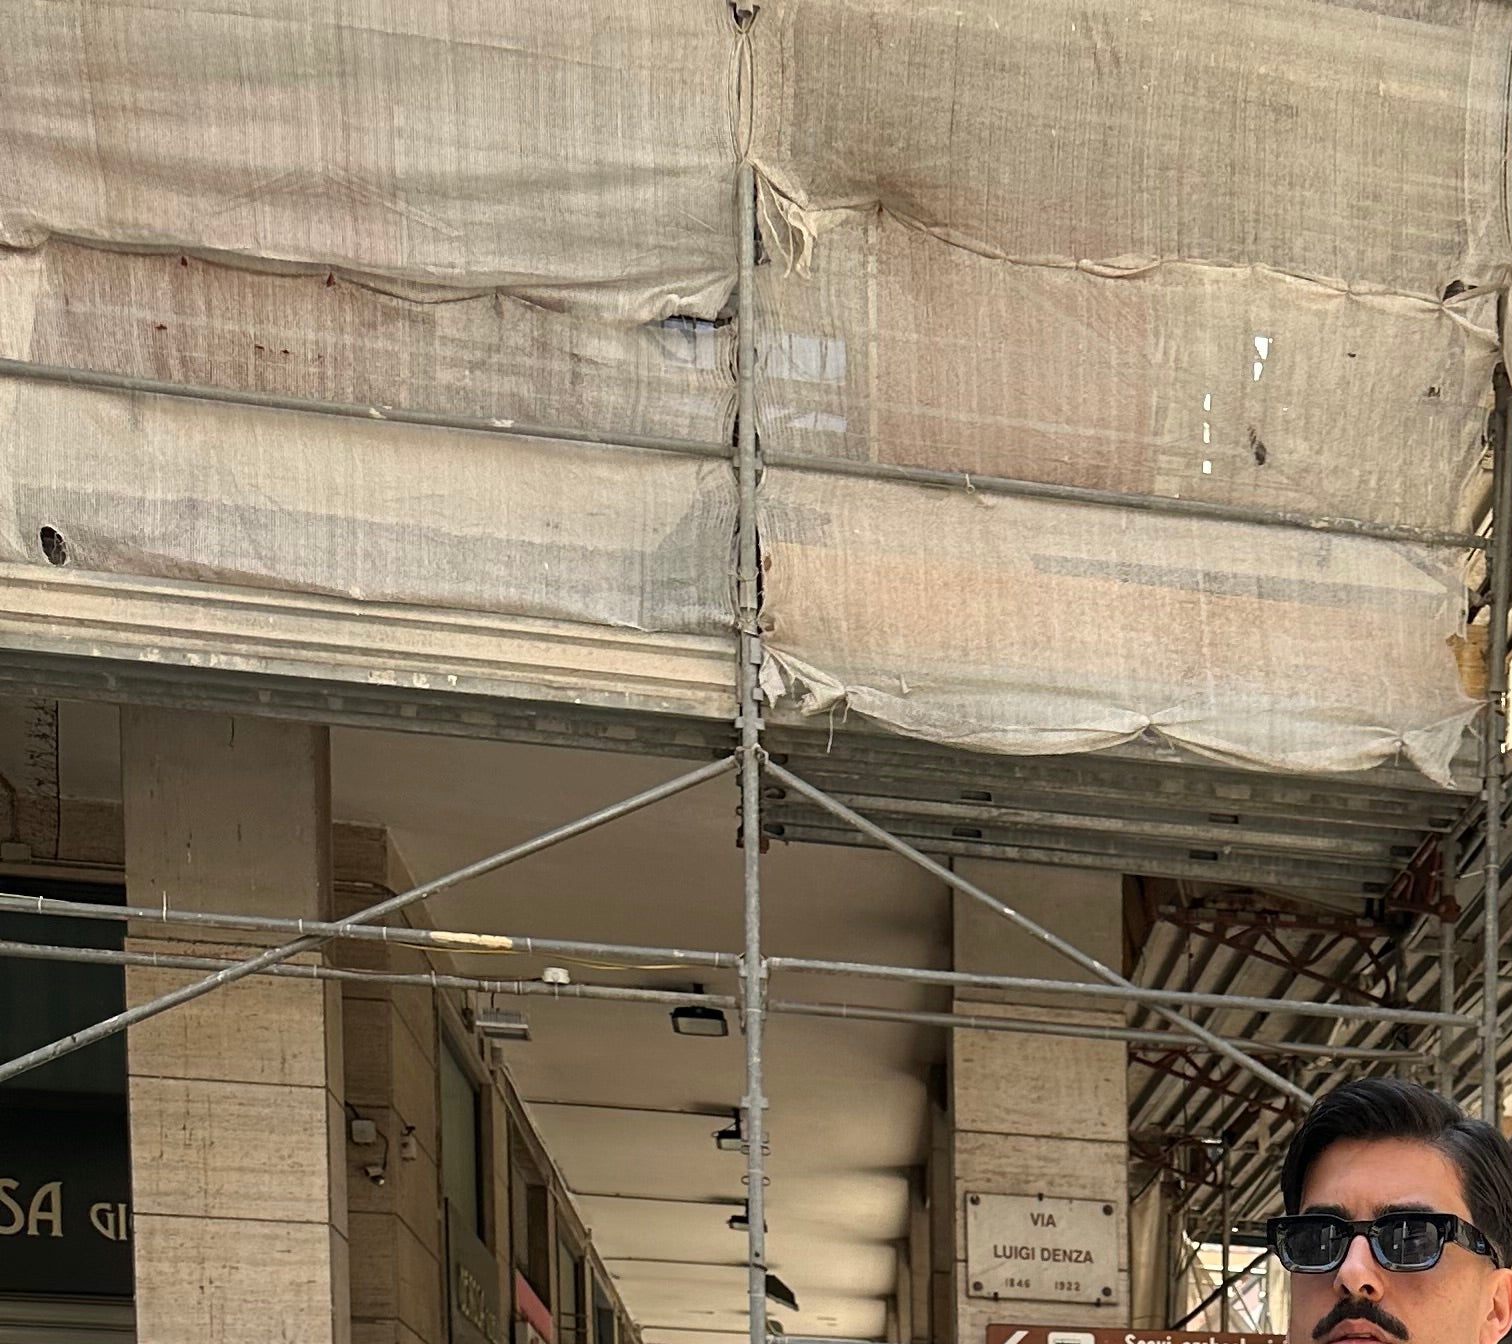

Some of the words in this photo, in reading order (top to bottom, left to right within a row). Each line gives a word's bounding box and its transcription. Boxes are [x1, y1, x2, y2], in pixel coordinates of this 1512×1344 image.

[90, 1202, 133, 1240] GI
[1030, 1212, 1057, 1228] VIA
[993, 1244, 1035, 1261] LUIGI
[1040, 1246, 1094, 1264] DENZA
[1004, 1278, 1031, 1289] 1846
[1054, 1280, 1081, 1292] 1922
